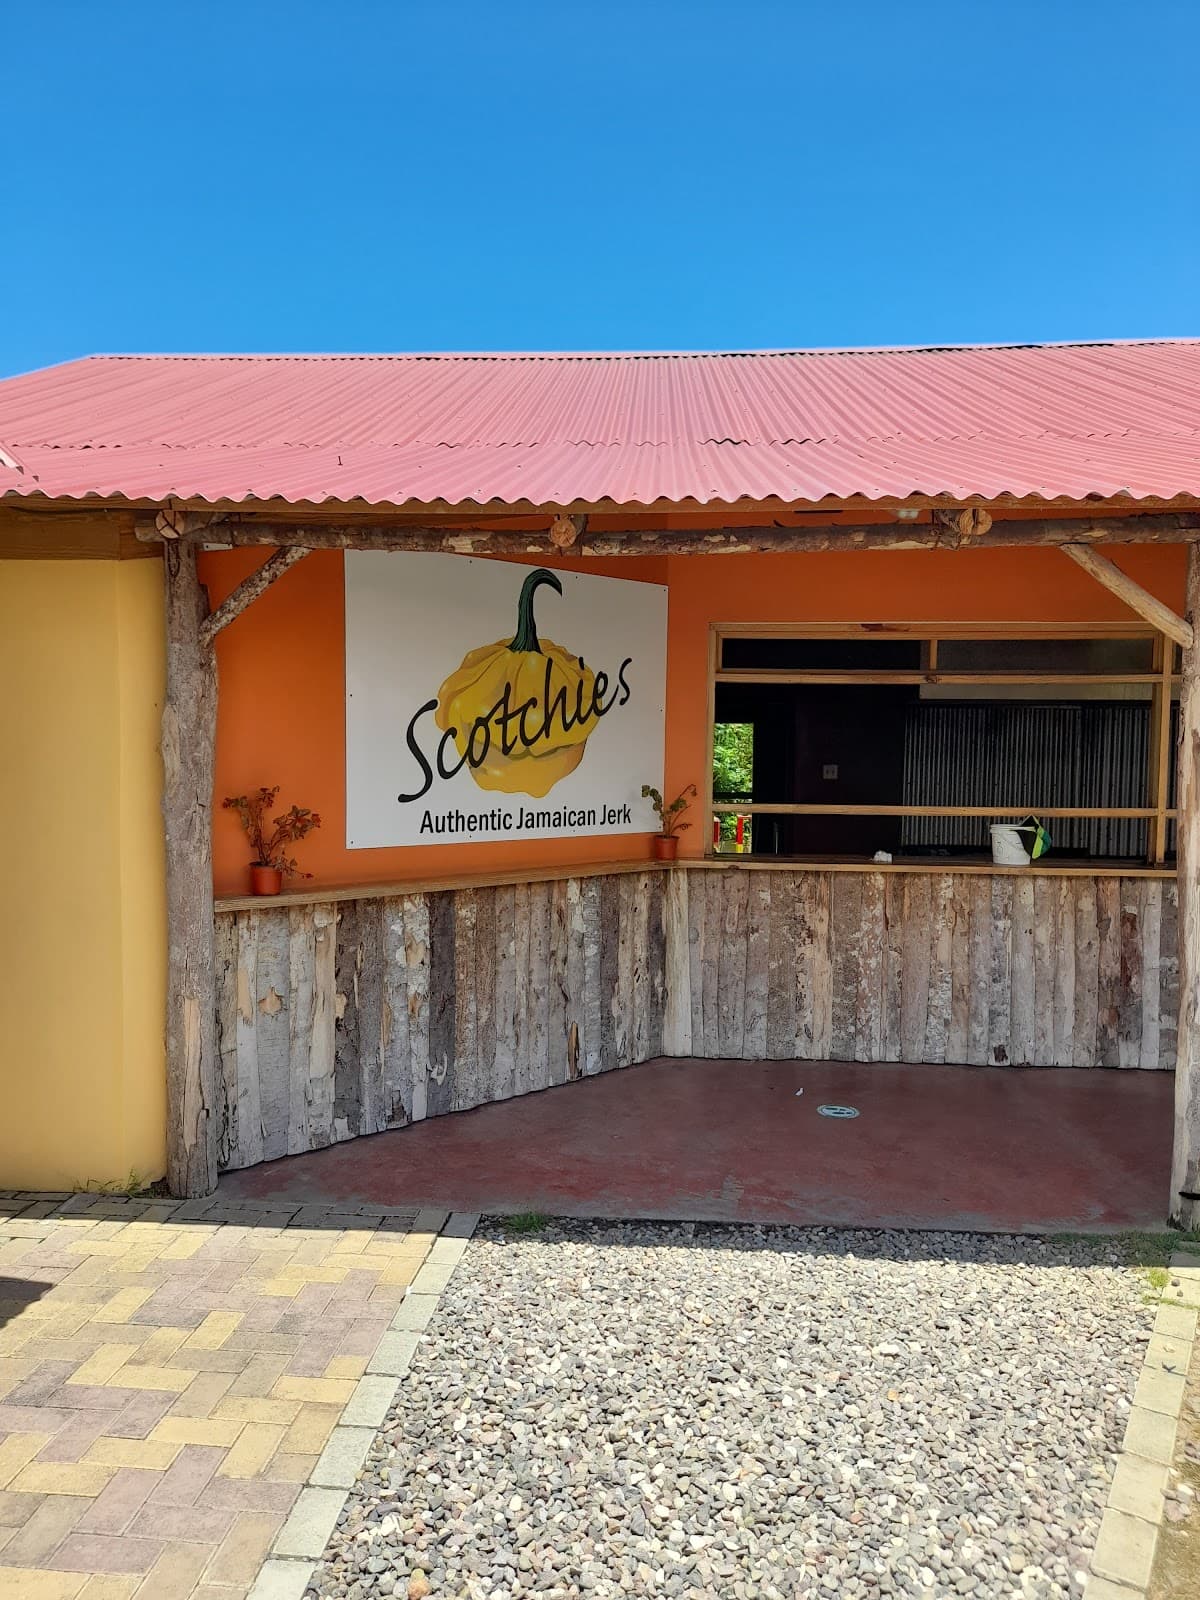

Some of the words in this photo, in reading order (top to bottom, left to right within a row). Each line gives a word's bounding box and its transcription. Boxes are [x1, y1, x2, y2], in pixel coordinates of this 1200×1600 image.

[397, 656, 633, 803] Scotchies
[419, 808, 513, 834] Authentic
[516, 806, 596, 830] Jamaican
[600, 804, 632, 826] Jerk
